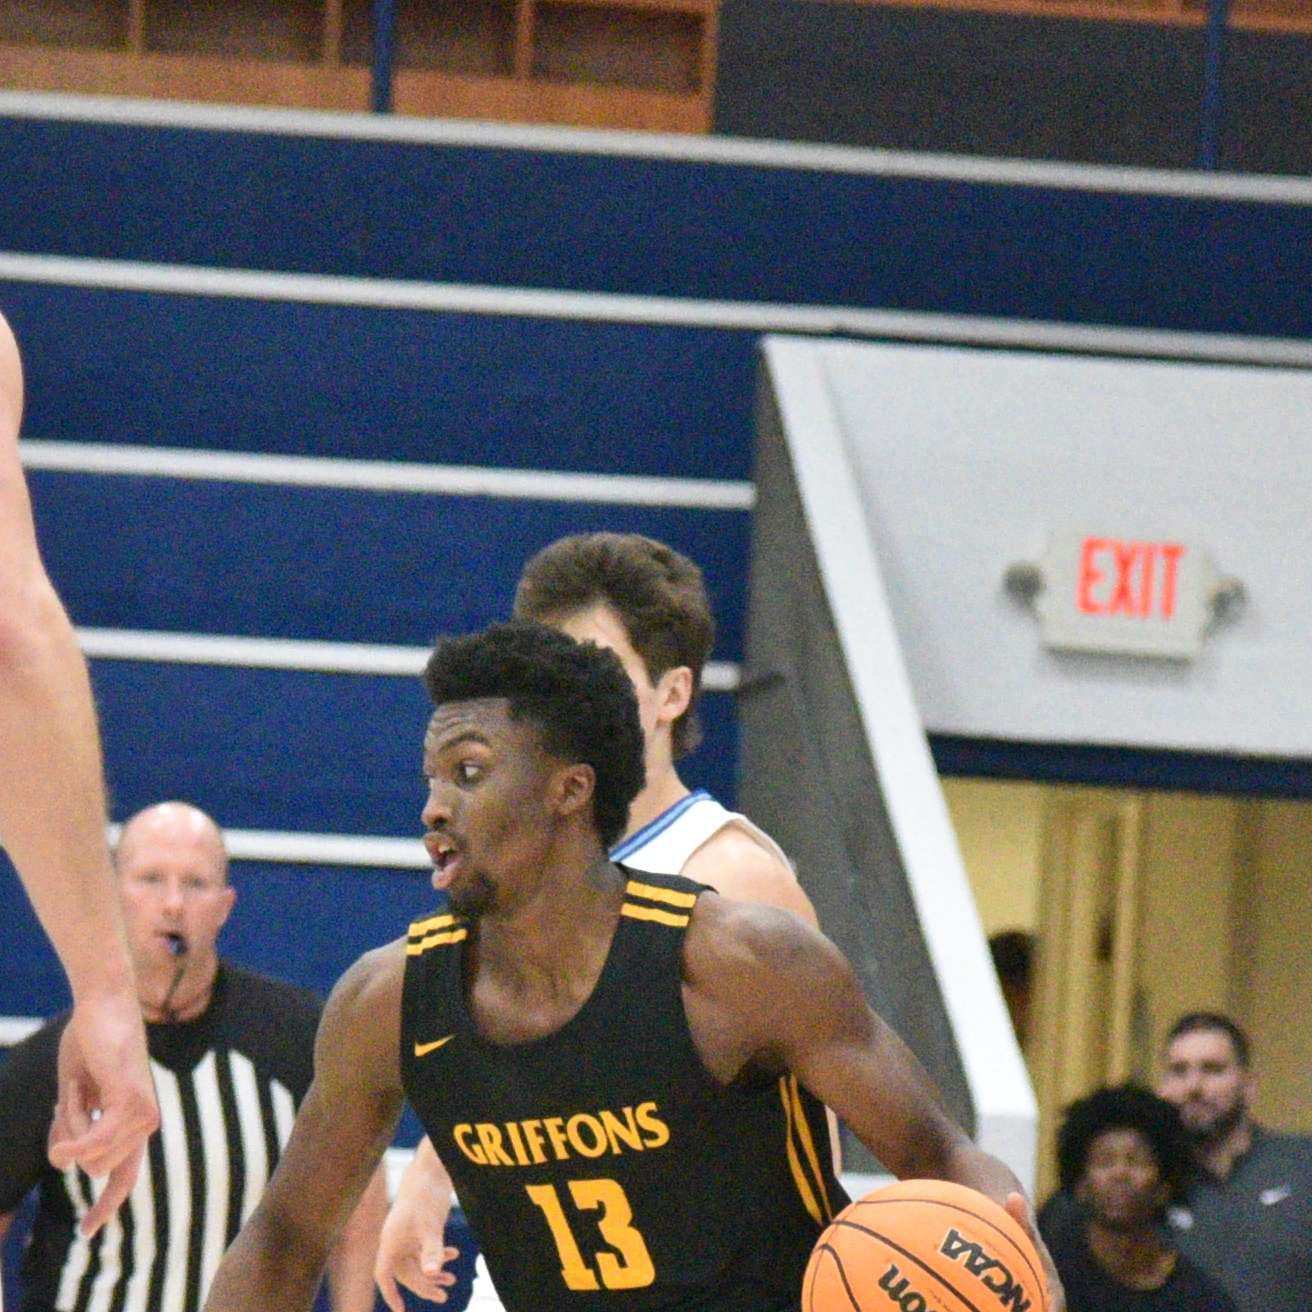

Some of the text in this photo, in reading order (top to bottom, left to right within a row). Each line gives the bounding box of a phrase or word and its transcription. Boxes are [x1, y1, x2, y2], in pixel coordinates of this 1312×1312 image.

[1078, 536, 1186, 619] EXIT
[453, 1101, 670, 1166] GRIFFONS
[525, 1178, 656, 1291] 13
